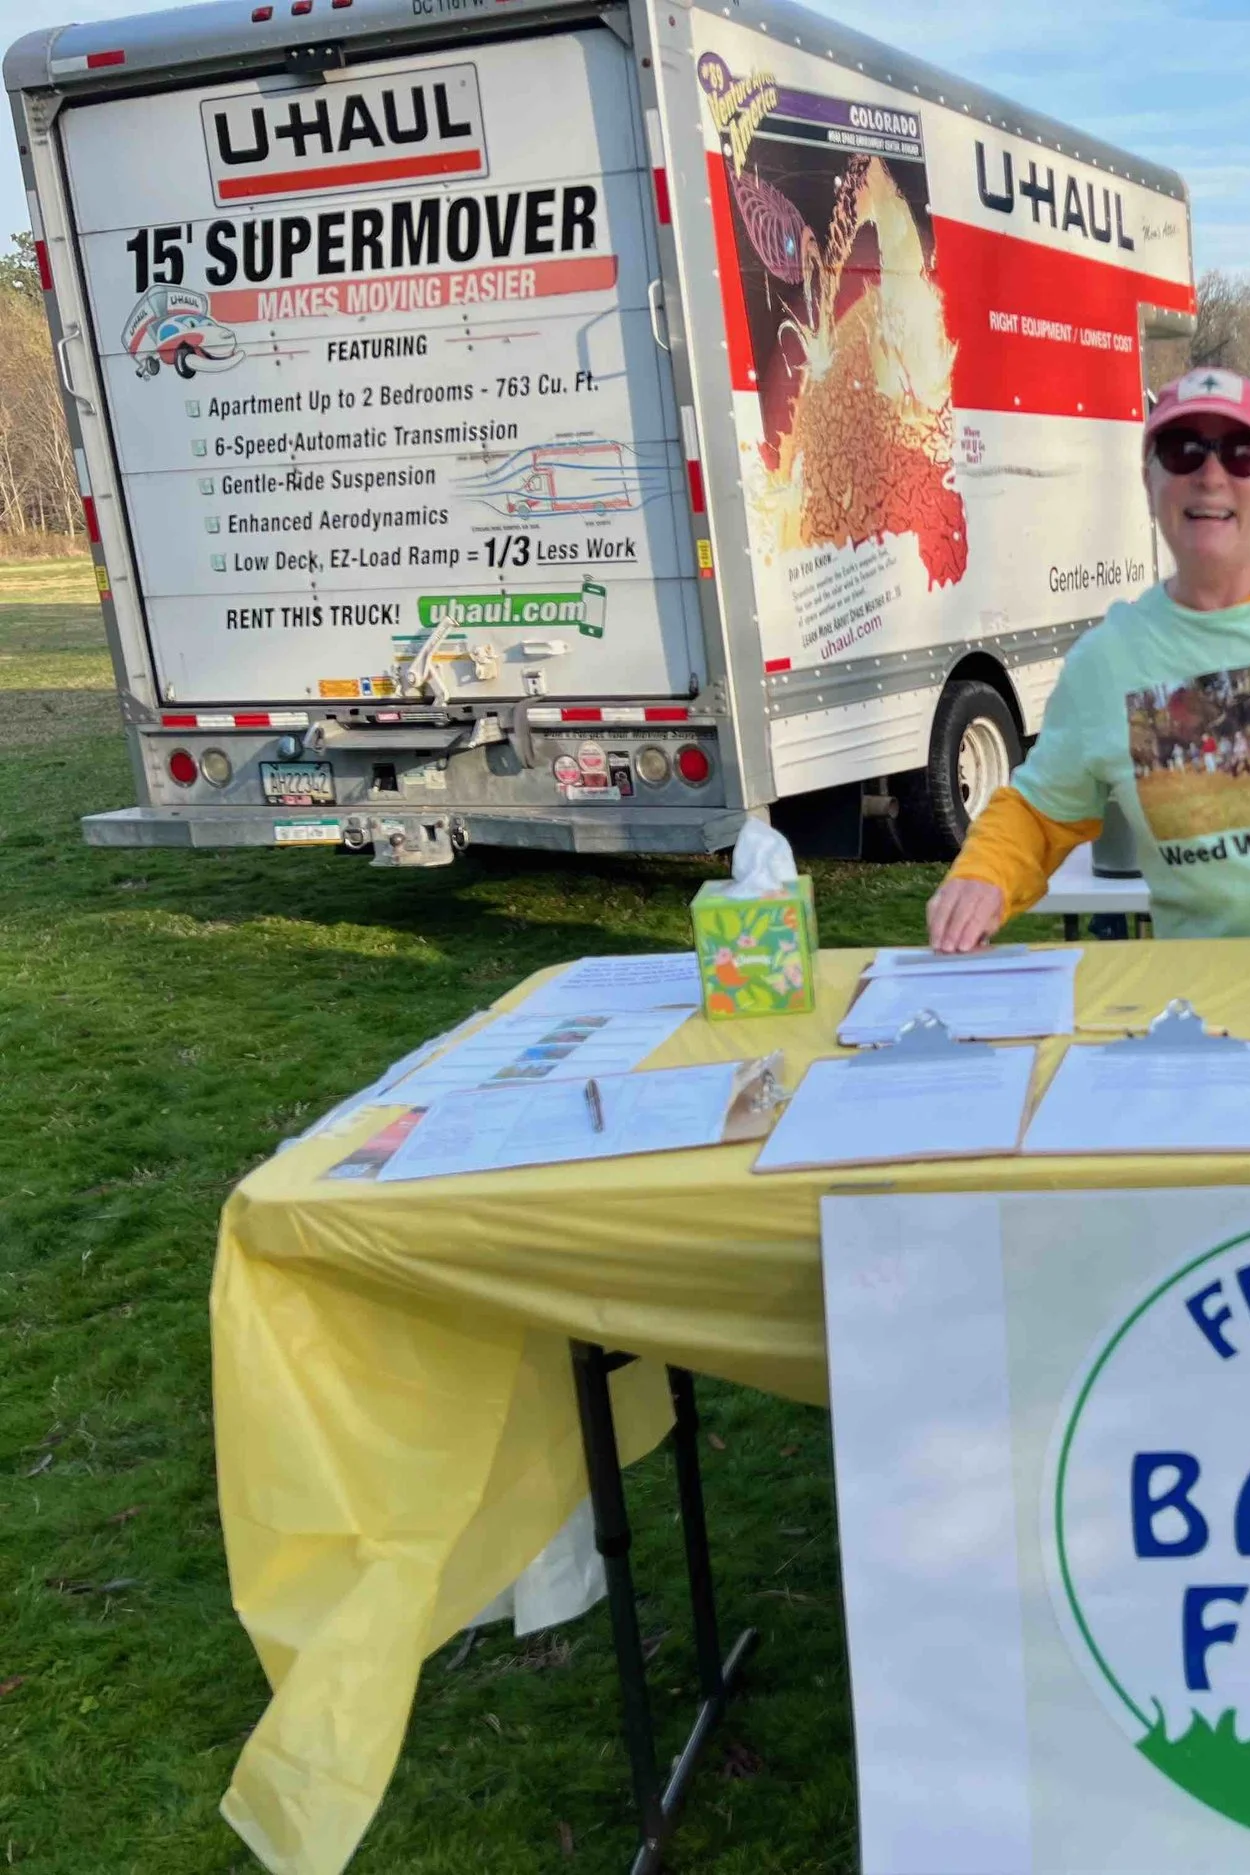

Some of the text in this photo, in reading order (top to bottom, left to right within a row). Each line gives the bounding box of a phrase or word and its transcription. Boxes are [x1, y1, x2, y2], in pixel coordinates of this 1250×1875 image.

[850, 105, 918, 138] COLORADO
[126, 186, 597, 293] 15' SUPERMOVER
[257, 269, 536, 321] MAKES MOVING EASIER
[327, 335, 428, 362] FEATURING
[989, 310, 1018, 333] RIGHT
[1021, 317, 1073, 343] EQUIPMENT
[1080, 328, 1111, 349] LOWEST
[1113, 334, 1133, 352] COST
[208, 392, 302, 420] Apartment
[309, 390, 331, 414] Up
[339, 388, 355, 408] to
[362, 387, 373, 406] 2
[380, 383, 474, 405] Bedrooms
[496, 375, 530, 398] 763
[538, 374, 567, 394] Cu.
[575, 370, 599, 393] Ft.
[215, 419, 518, 459] 6-Speed Automatic Transmission
[222, 465, 436, 494] Gentle-Ride Suspension
[228, 505, 449, 534] Enhanced Aerodynamics
[234, 535, 637, 573] Low Deck, EZ-Load Ramp = 1/3 Less Work
[1049, 557, 1145, 593] Gentle-Ride Van
[227, 604, 400, 630] RENT THIS TRUCK!
[429, 597, 587, 623] uhaul.com
[820, 615, 882, 660] uhaul.com
[1159, 842, 1228, 866] Weed
